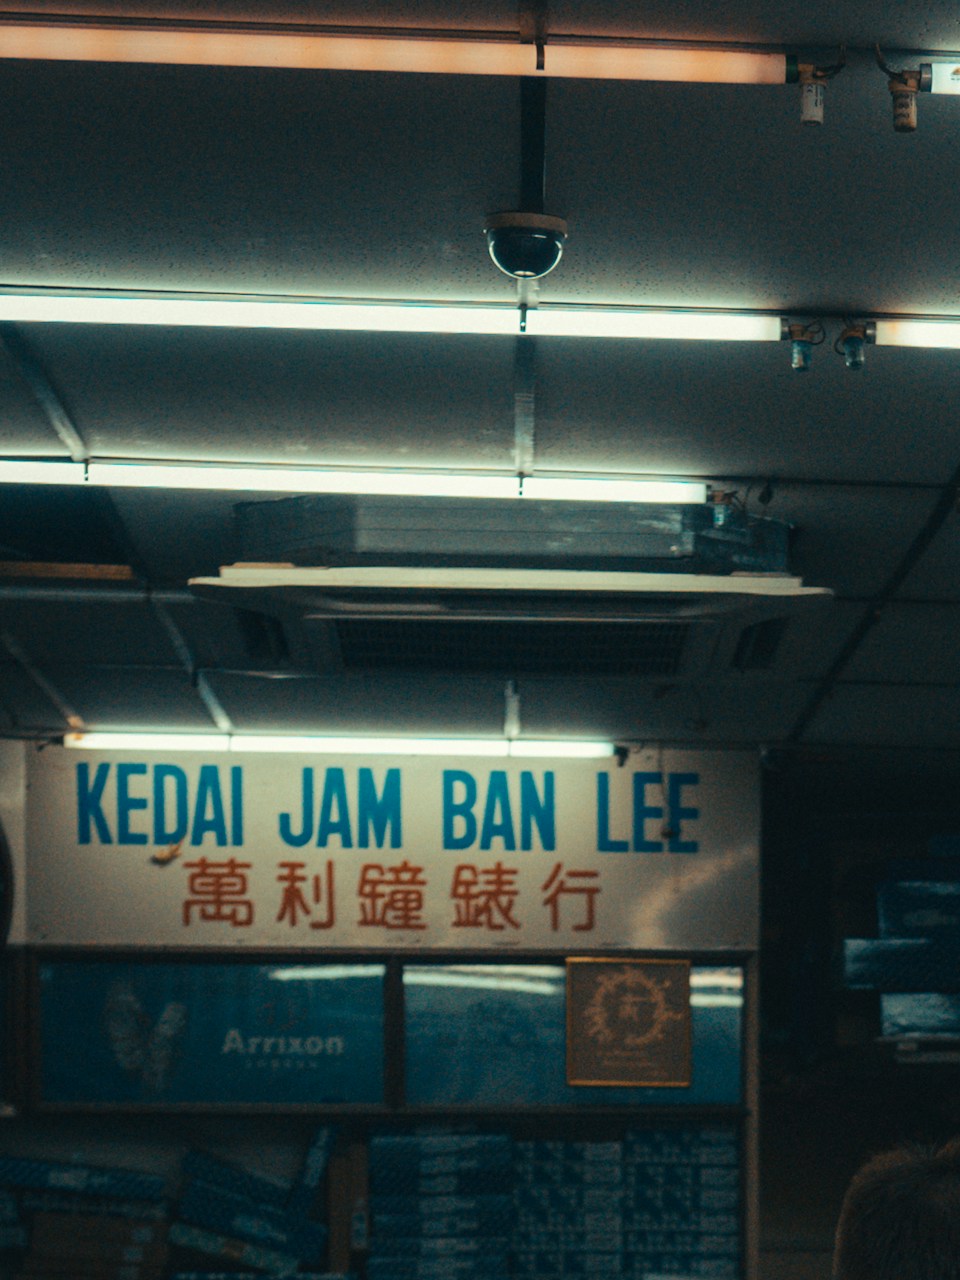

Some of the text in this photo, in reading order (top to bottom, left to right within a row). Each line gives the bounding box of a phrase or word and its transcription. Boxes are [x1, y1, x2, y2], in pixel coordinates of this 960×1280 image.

[77, 763, 699, 853] KEDAI JAM BAN LEE
[183, 857, 601, 931] 萬利鐘錶行
